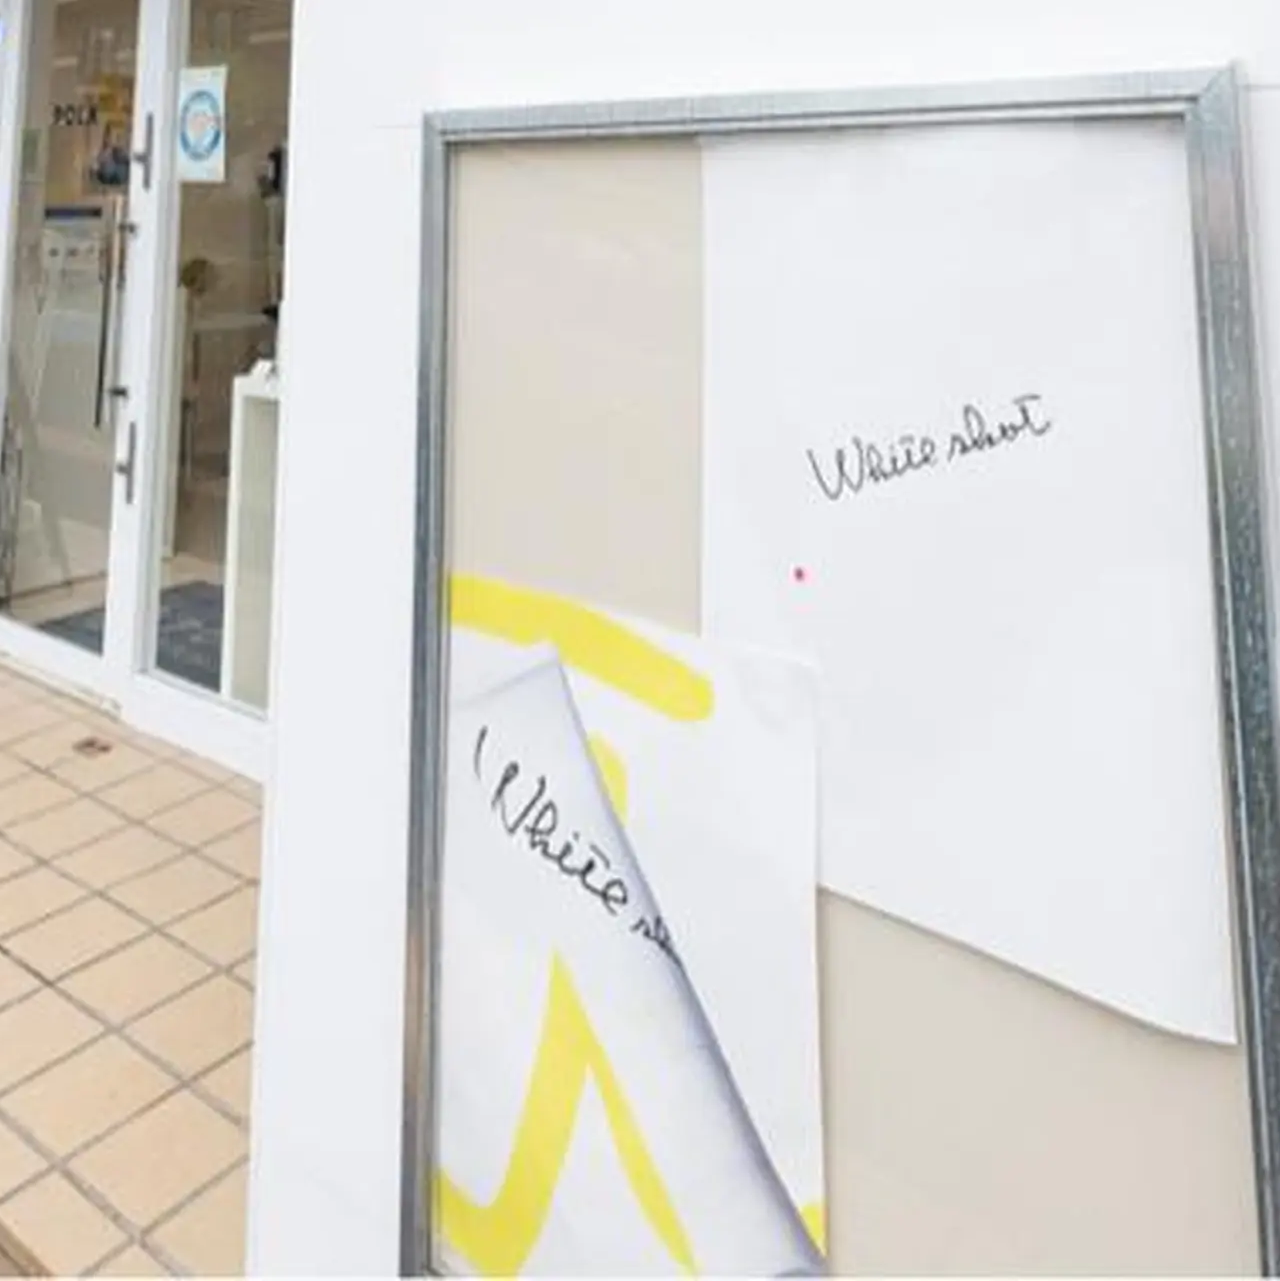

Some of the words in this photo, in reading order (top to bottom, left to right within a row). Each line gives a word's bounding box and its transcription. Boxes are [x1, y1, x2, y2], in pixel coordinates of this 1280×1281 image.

[52, 103, 98, 127] POLA
[806, 434, 937, 501] White
[947, 393, 1051, 457] shot
